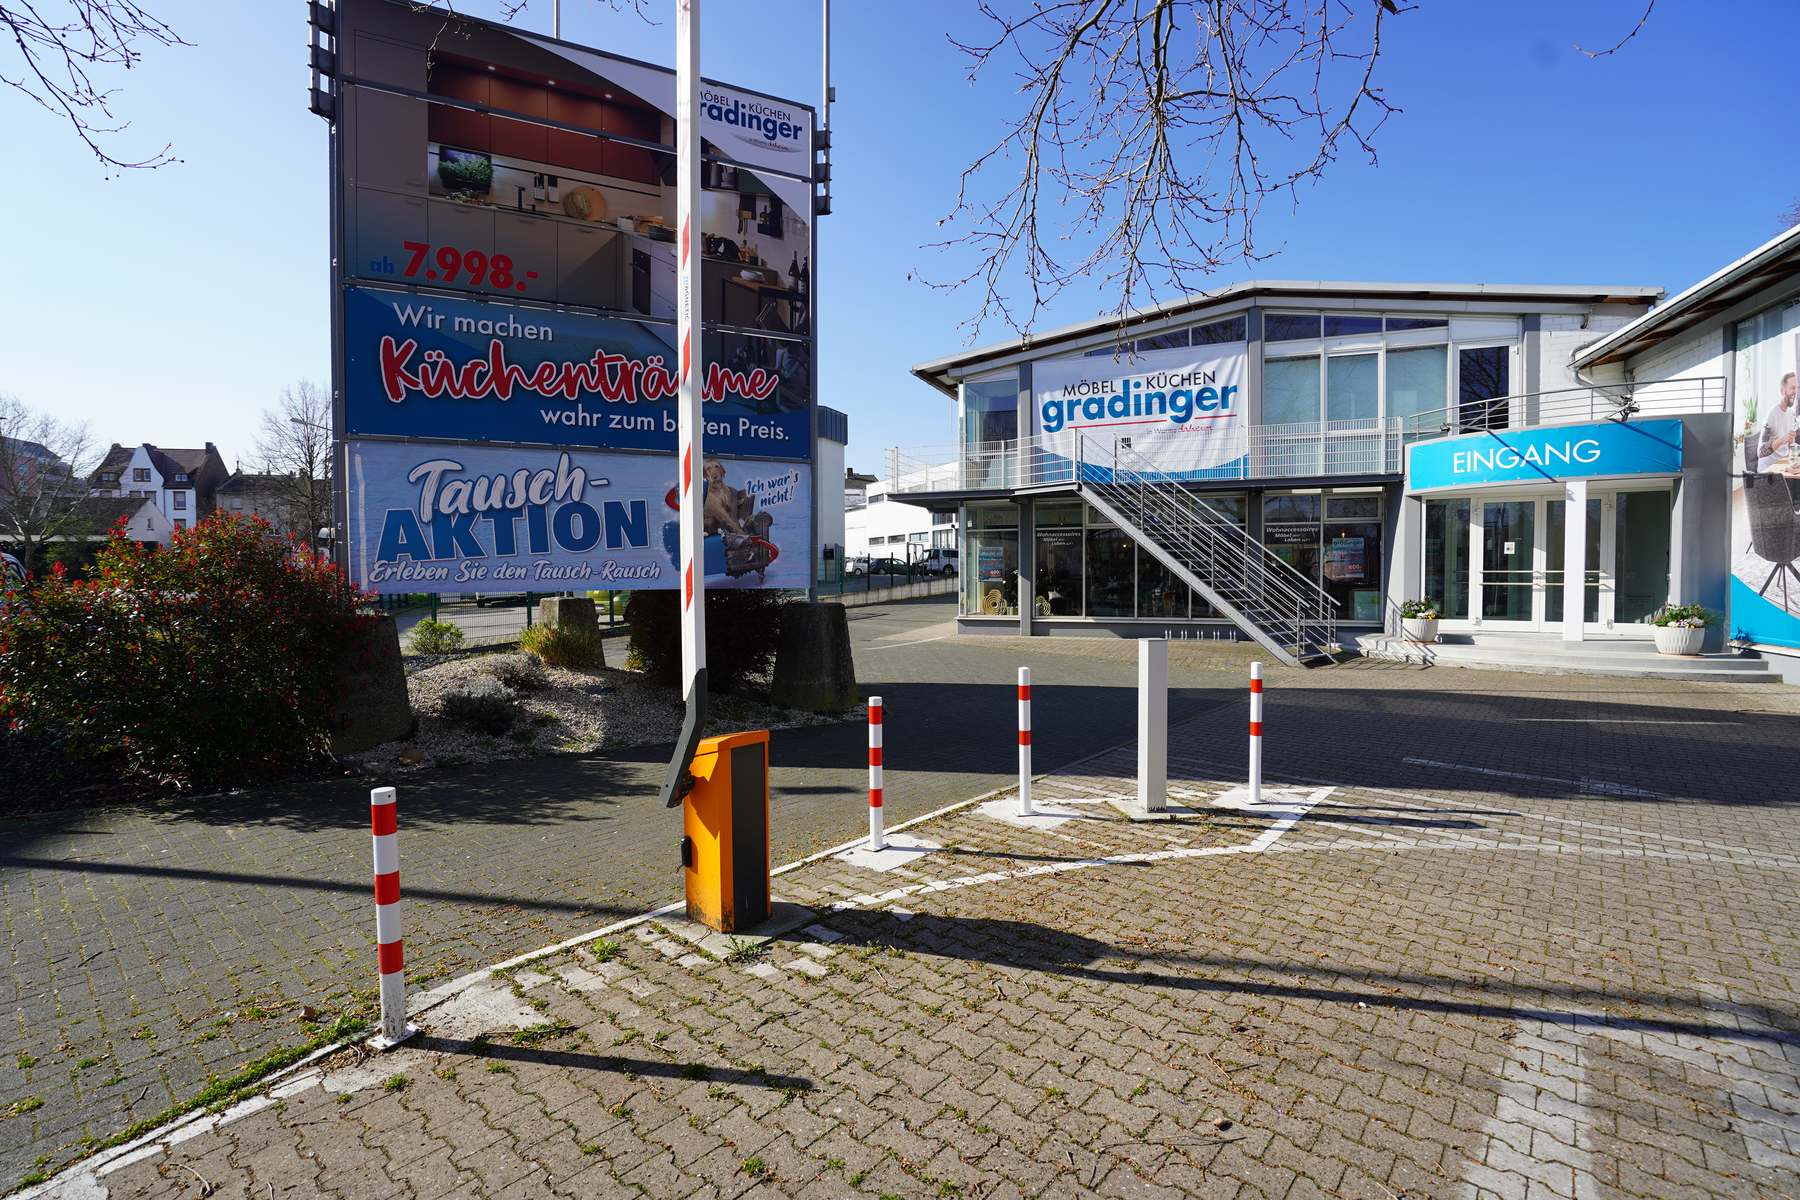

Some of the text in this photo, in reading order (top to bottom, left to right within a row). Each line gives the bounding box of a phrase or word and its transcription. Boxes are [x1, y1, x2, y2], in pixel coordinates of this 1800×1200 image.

[700, 90, 791, 122] ÖBEL KÜCHEN
[700, 100, 803, 141] radinger
[369, 240, 539, 292] ab 7.998.-
[392, 302, 554, 341] Wir machen
[380, 336, 779, 403] Küchenträme
[1063, 370, 1216, 397] MÖBEL KÜCHEN
[540, 404, 602, 428] wahr
[608, 413, 655, 432] zum
[738, 417, 790, 441] Preis.
[1041, 379, 1238, 433] gradinger
[1453, 439, 1601, 474] EINGANG
[407, 451, 610, 524] Tausch-
[746, 479, 765, 496] Ich
[760, 486, 794, 507] nicht!
[375, 500, 650, 563] AKTION
[369, 559, 449, 583] Erleben
[454, 559, 487, 582] Sie
[493, 561, 527, 580] den
